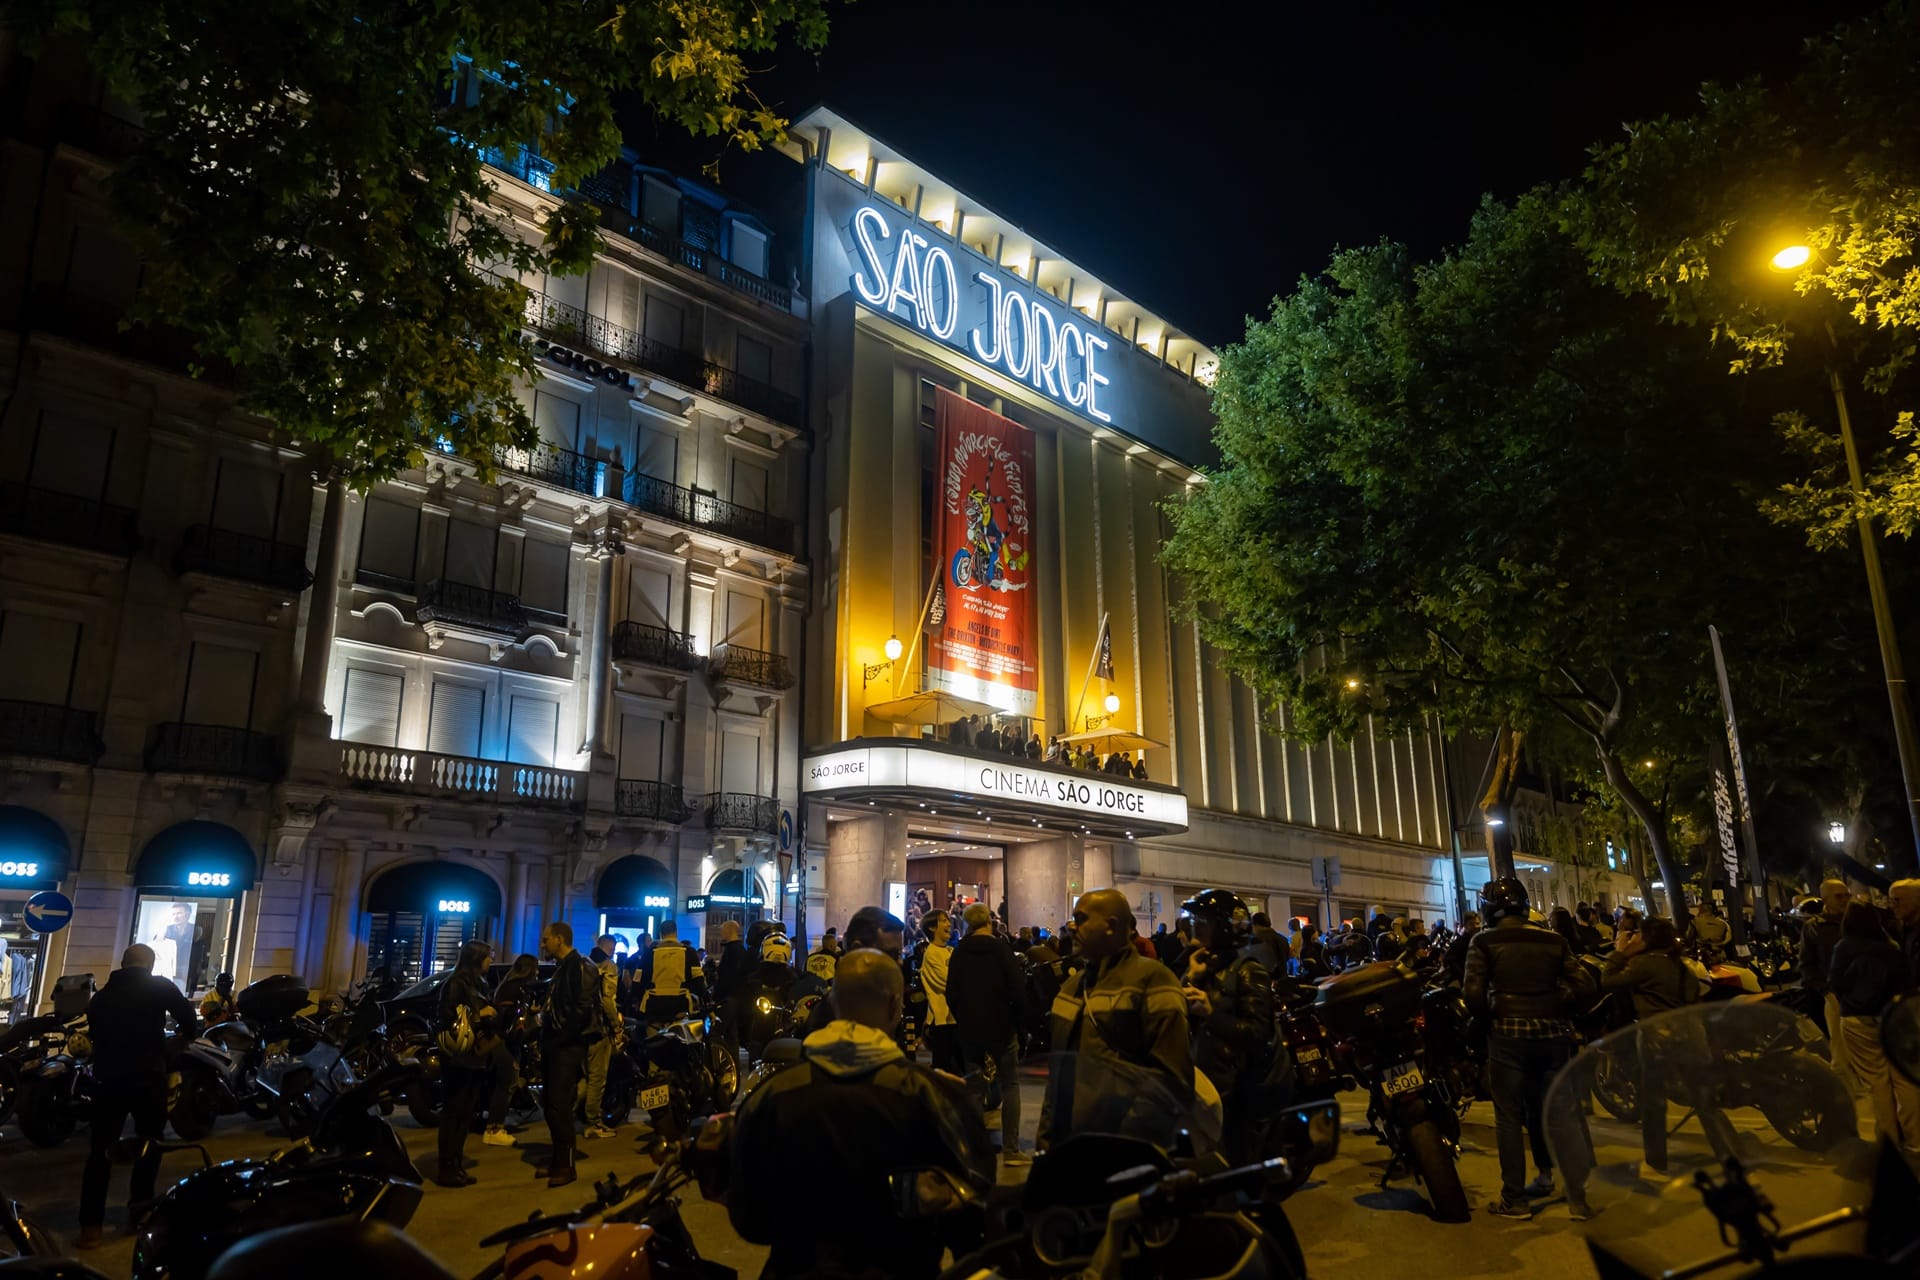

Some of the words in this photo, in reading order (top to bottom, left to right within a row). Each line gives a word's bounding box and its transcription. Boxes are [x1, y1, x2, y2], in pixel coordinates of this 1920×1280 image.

[852, 206, 958, 340] SÃO
[811, 766, 829, 780] SÃO
[832, 762, 865, 777] JORGE
[980, 767, 1050, 798] CINEMA
[1057, 779, 1090, 806] SÃO
[1096, 786, 1144, 813] JORGE
[188, 871, 230, 887] BOSS
[438, 900, 470, 913] BOSS
[644, 895, 671, 908] BOSS
[688, 899, 705, 909] BOSS
[1391, 1066, 1407, 1079] AU
